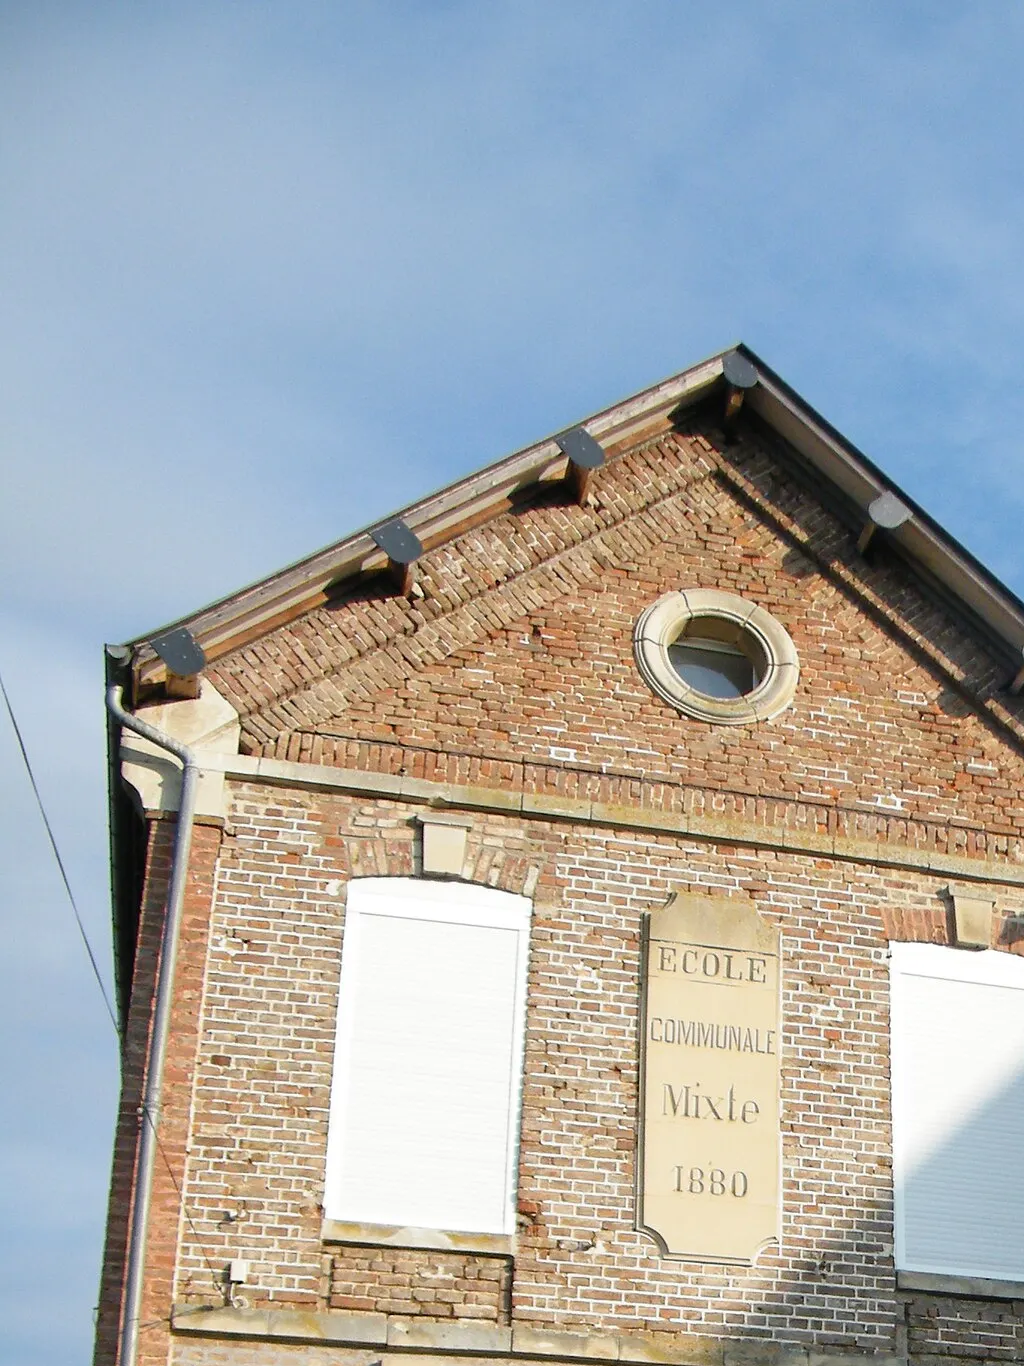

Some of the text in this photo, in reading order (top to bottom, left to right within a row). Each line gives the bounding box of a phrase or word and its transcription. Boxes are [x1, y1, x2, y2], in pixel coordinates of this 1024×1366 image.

[657, 946, 767, 984] ECOLE
[650, 1017, 776, 1055] COMMUNALE
[662, 1082, 760, 1124] Mixte
[672, 1165, 748, 1198] 1880
